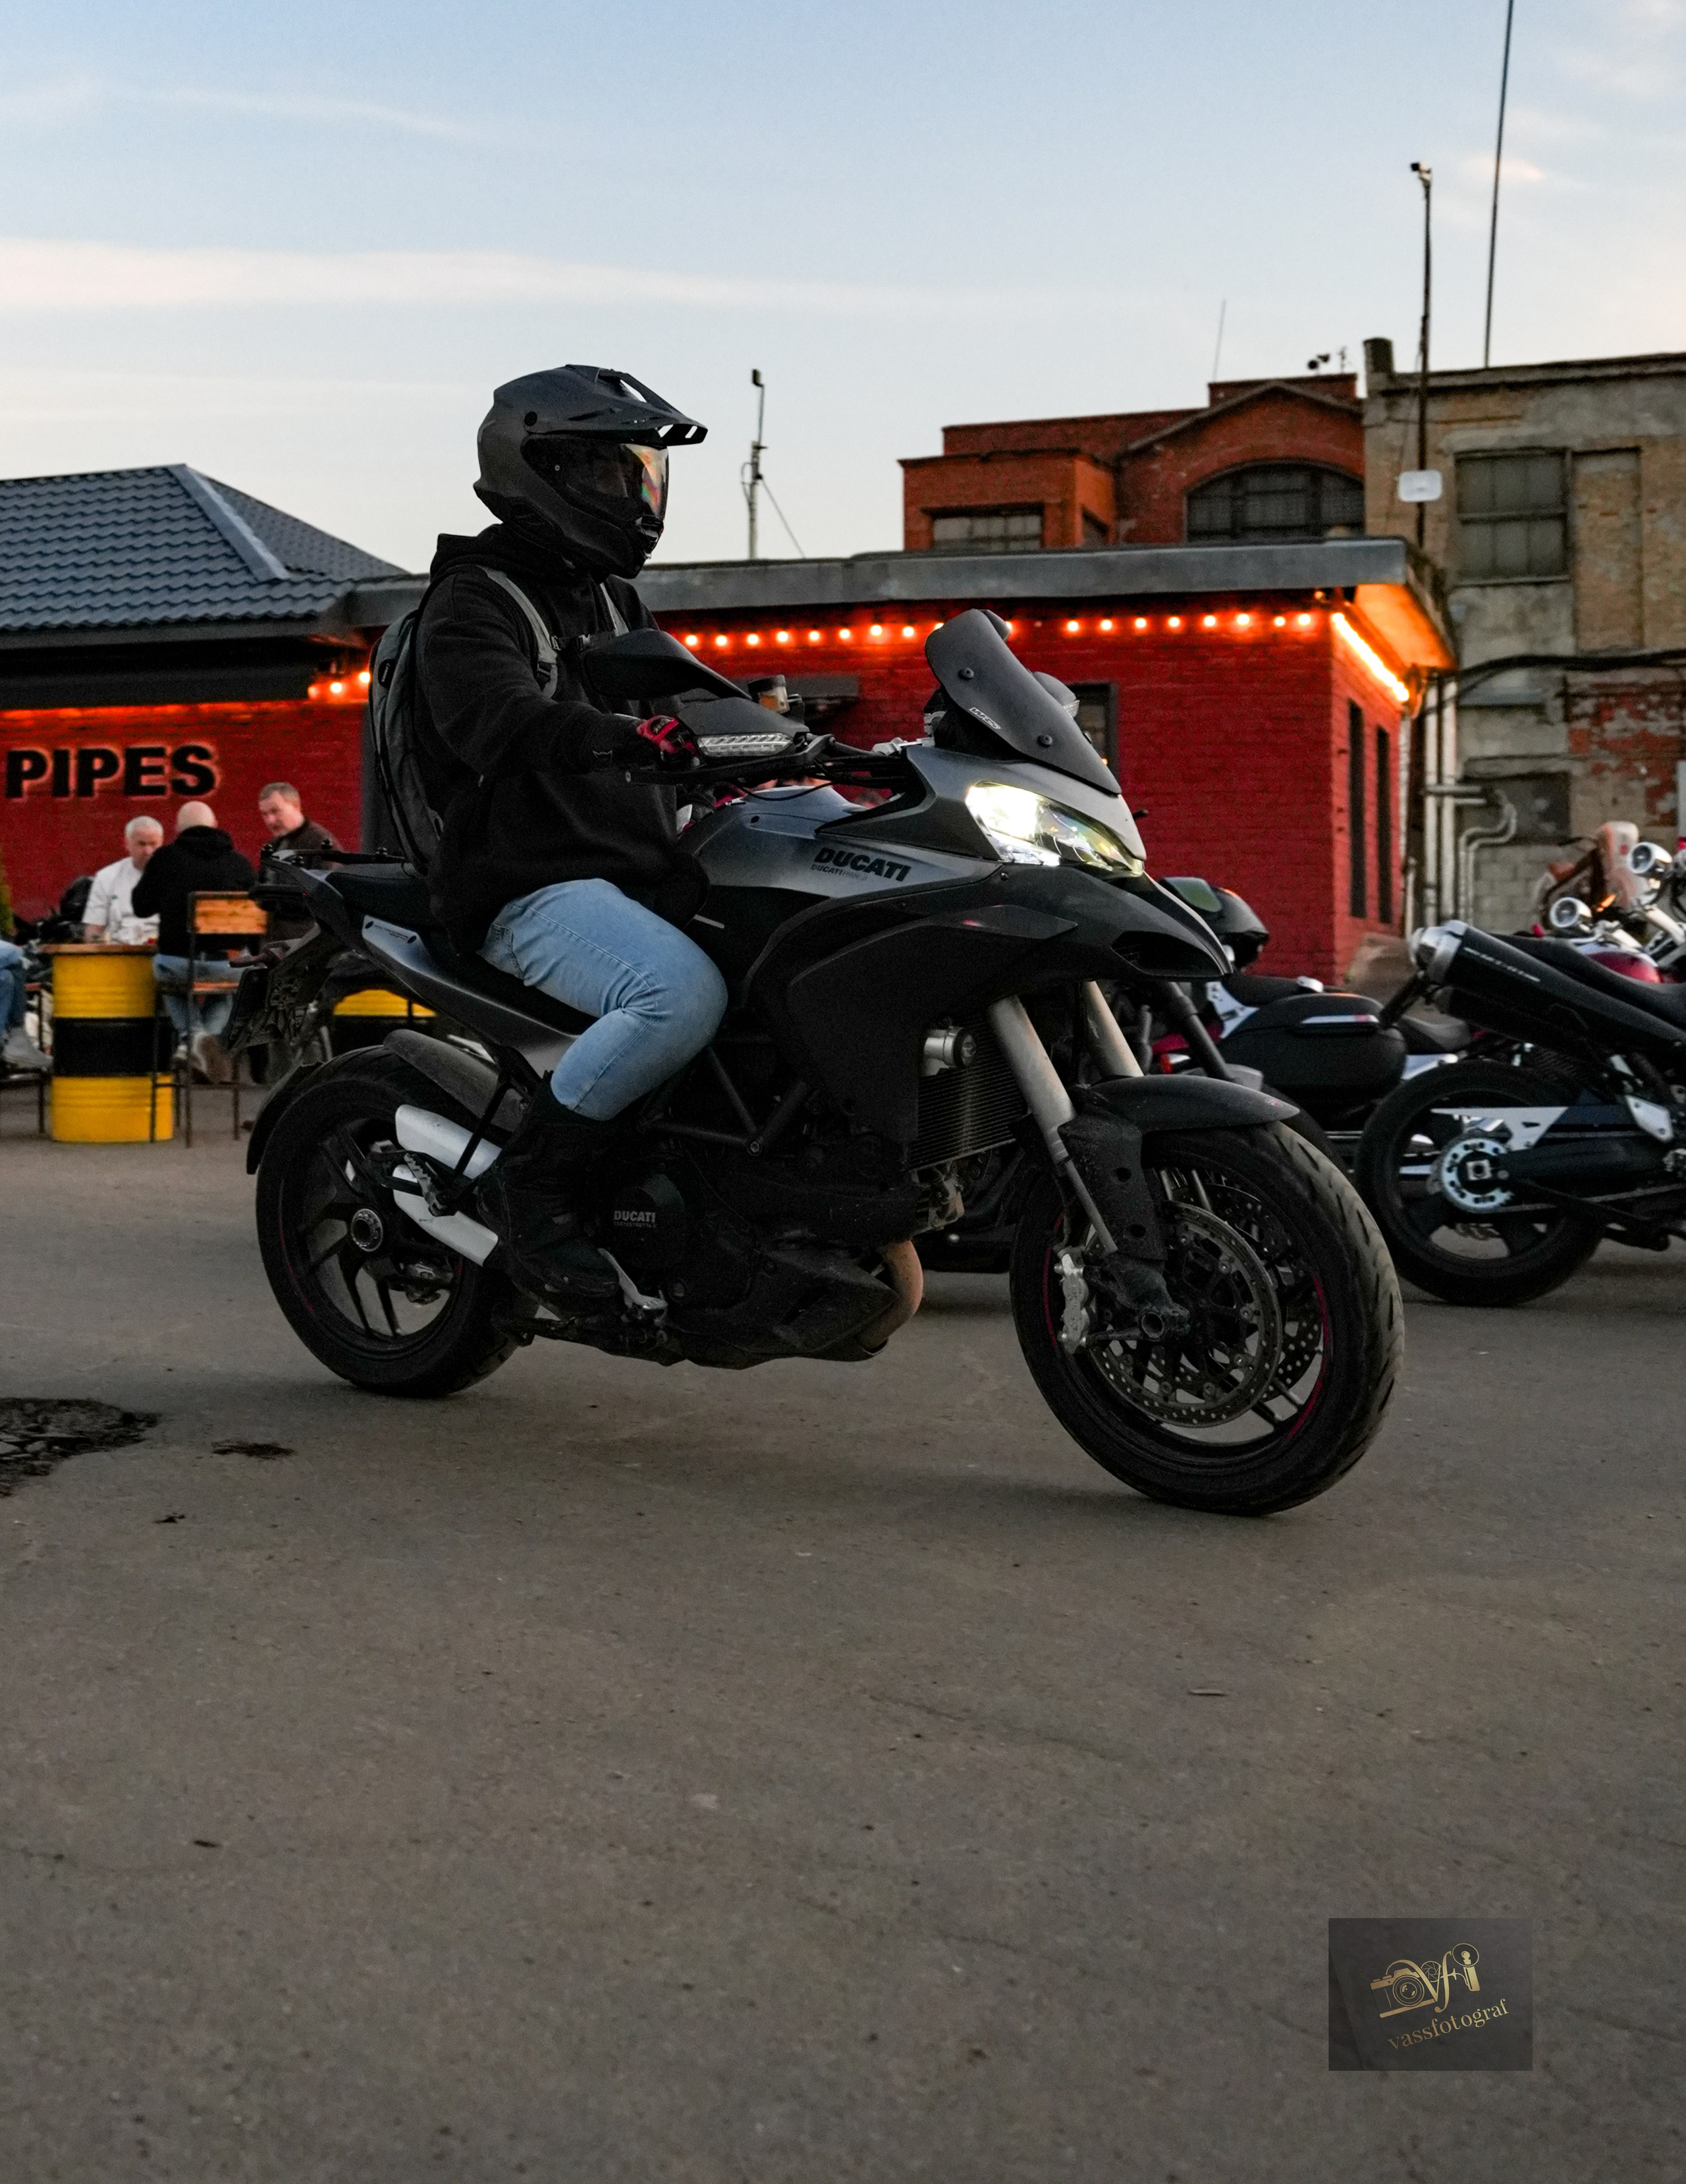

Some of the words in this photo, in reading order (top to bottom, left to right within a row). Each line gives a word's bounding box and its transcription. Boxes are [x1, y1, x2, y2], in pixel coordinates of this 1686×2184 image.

[5, 744, 216, 798] PIPES
[814, 847, 912, 882] DUCATI
[613, 1210, 657, 1222] DUCATI
